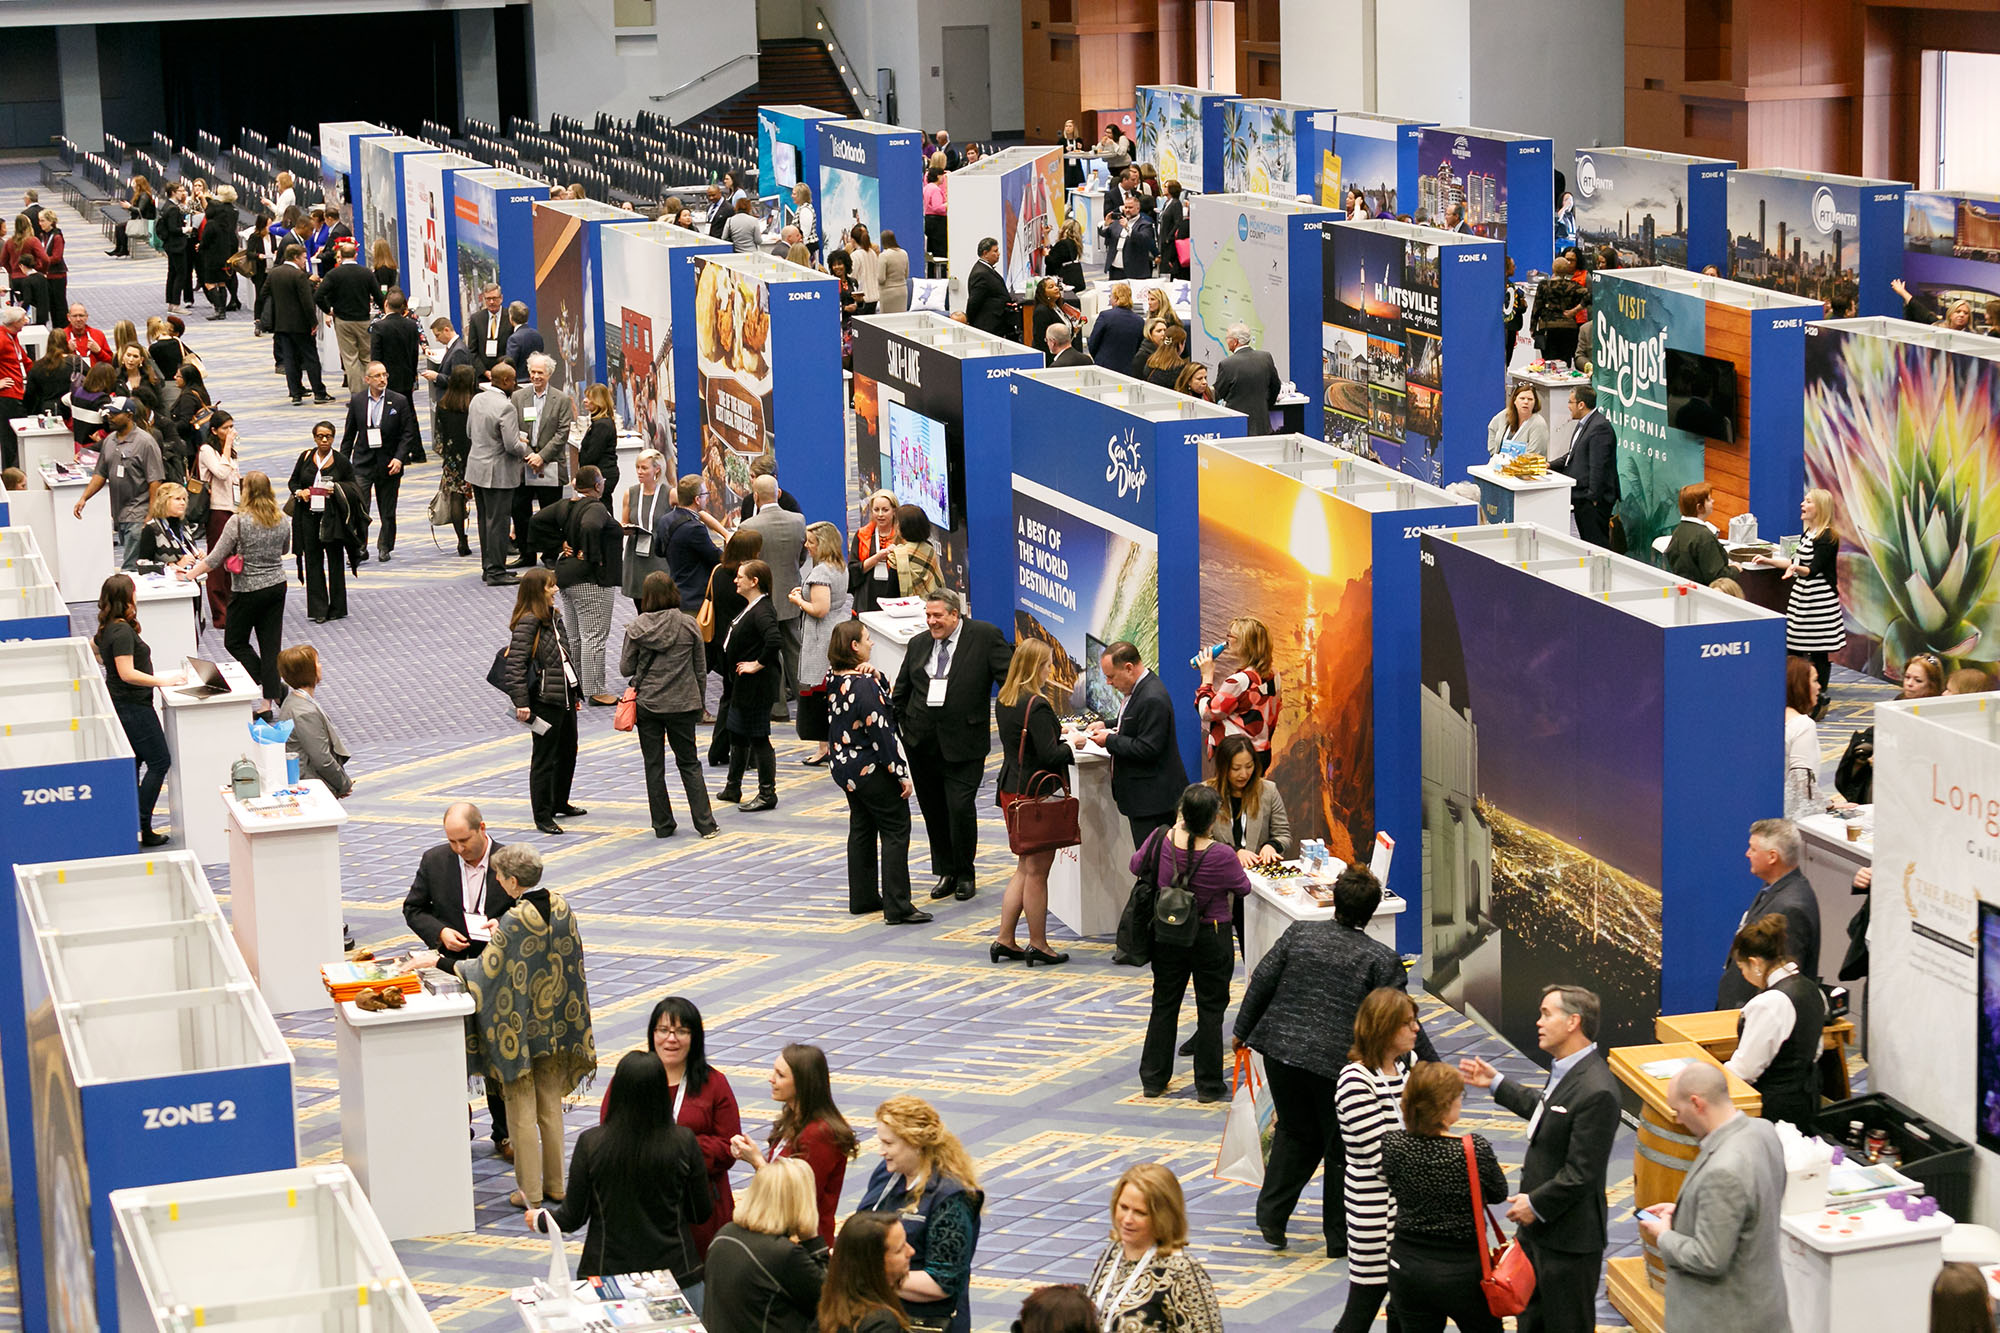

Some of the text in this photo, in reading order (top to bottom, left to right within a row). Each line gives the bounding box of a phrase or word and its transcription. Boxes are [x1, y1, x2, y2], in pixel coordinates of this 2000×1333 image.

[1583, 176, 1614, 191] ATLANTA
[1819, 210, 1857, 227] ATLANTA
[1250, 229, 1266, 240] COUNTY
[1458, 253, 1487, 263] ZONE 4
[788, 291, 821, 301] ZONE 4
[1618, 293, 1647, 320] VISIT
[1423, 316, 1438, 329] space
[1772, 319, 1803, 329] ZONE 1
[887, 339, 921, 388] SALT LAKE
[1117, 462, 1147, 503] Diego
[1018, 514, 1061, 552] A BEST OF
[1018, 539, 1069, 581] THE WORLD
[1019, 565, 1076, 612] DESTINATION
[1701, 641, 1751, 658] ZONE 1
[22, 784, 92, 806] ZONE 2
[142, 1099, 237, 1130] ZONE 2
